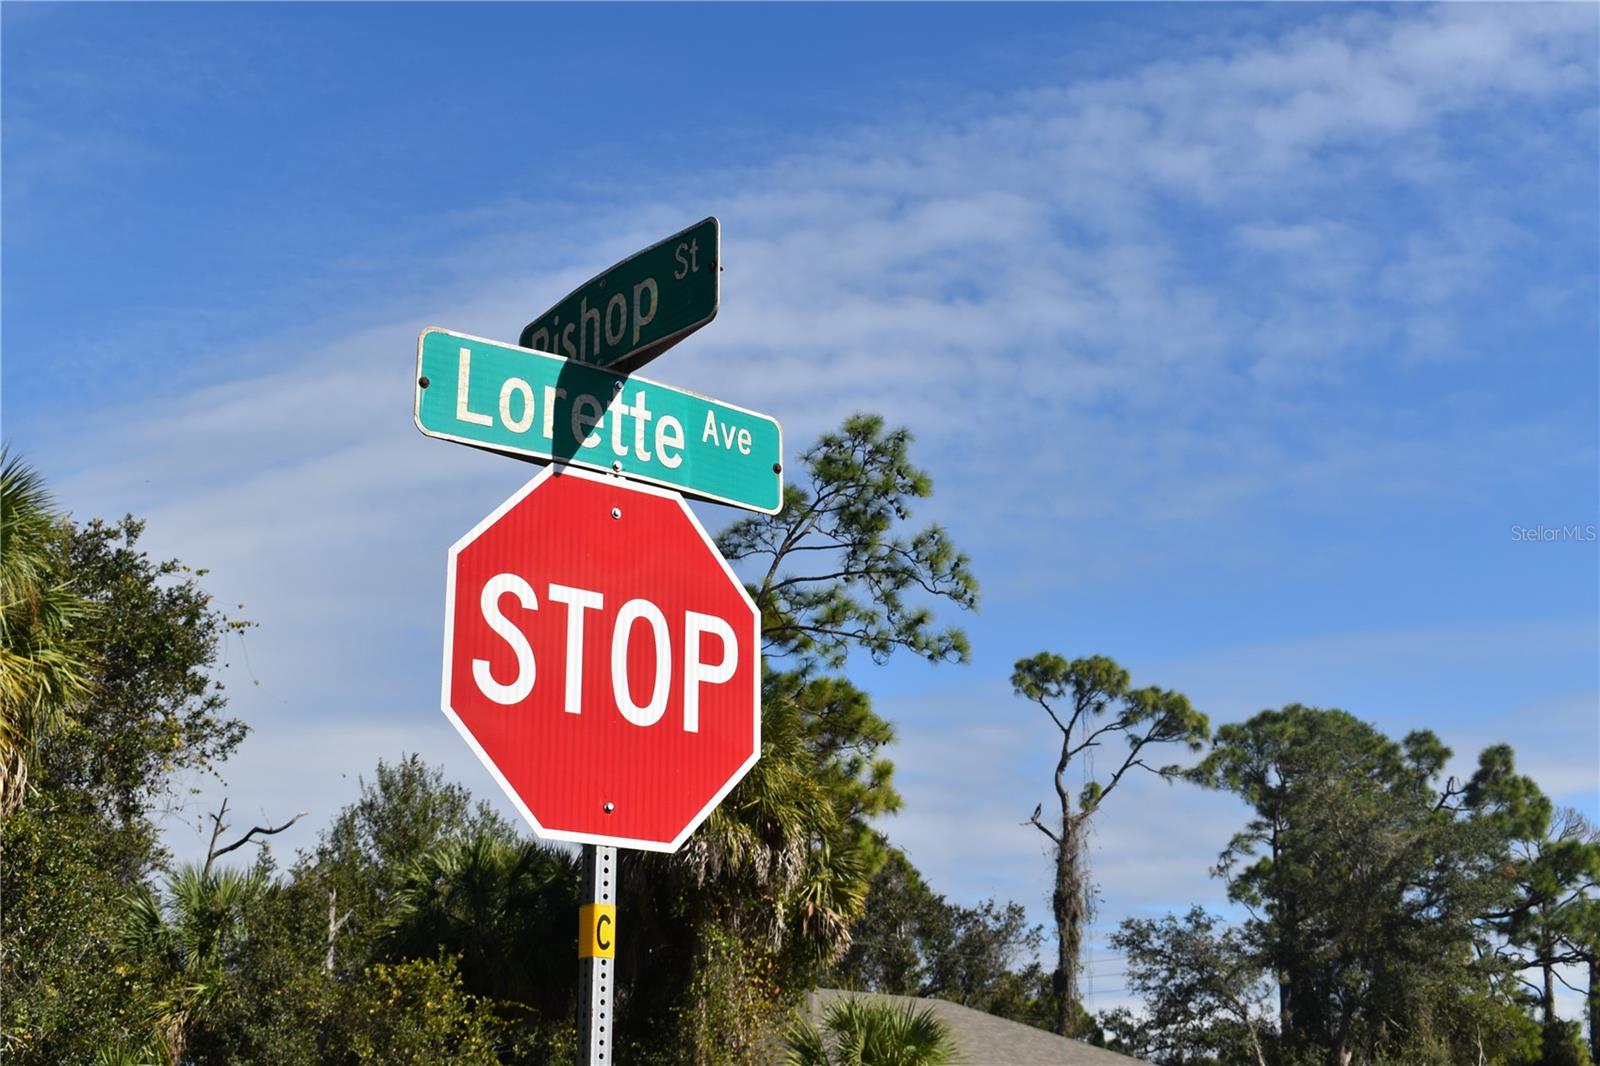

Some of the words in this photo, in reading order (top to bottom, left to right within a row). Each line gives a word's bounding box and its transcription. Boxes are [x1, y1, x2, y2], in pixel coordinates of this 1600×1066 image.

[674, 238, 699, 280] St
[456, 348, 685, 469] Lorette
[702, 410, 752, 455] Ave
[472, 573, 739, 733] STOP
[596, 914, 611, 950] C
